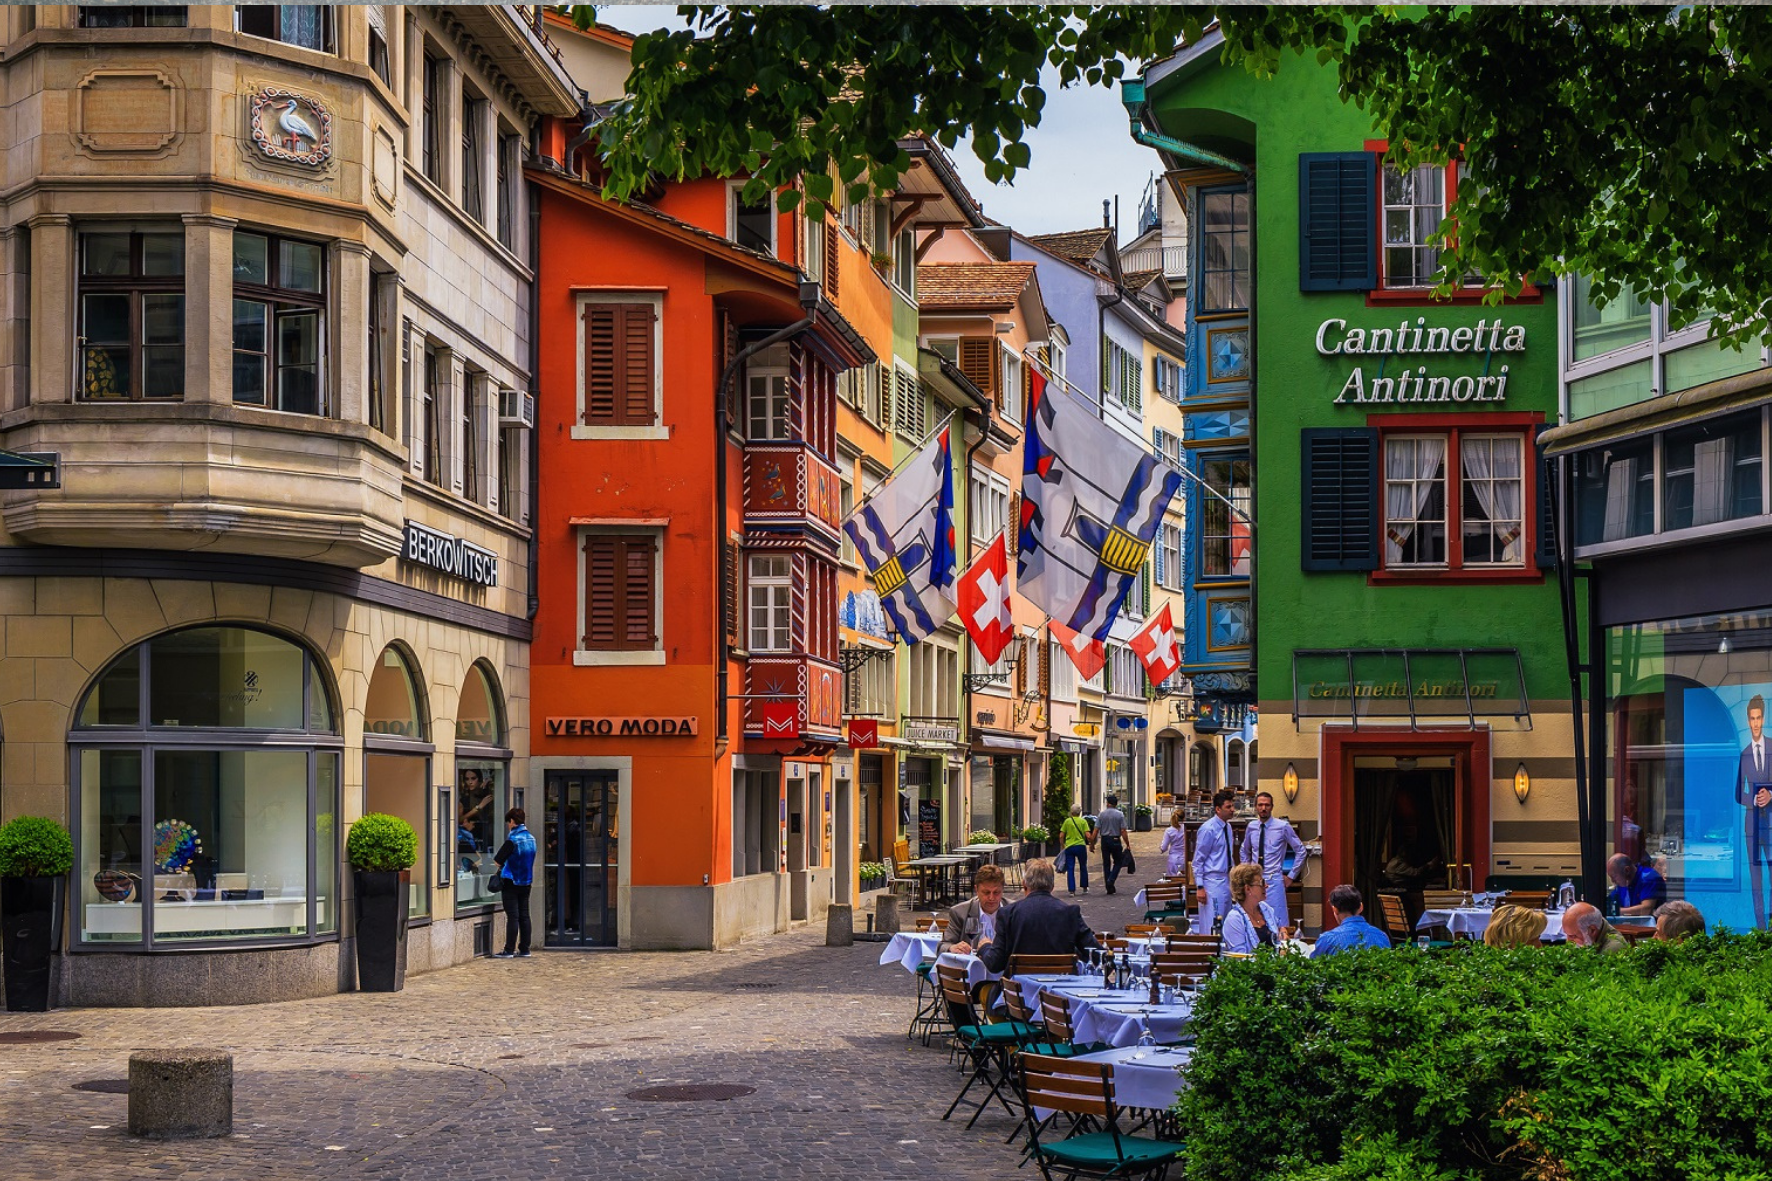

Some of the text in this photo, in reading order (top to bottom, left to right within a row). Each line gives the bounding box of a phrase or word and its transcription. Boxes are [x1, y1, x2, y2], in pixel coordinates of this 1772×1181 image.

[1315, 316, 1526, 355] Cantinetta
[1333, 365, 1509, 403] Antinori
[408, 527, 498, 586] BERKOWITSCH
[1309, 680, 1407, 698] Caninetta
[548, 718, 692, 735] VERO MODA
[907, 729, 955, 739] JUICE MARKET
